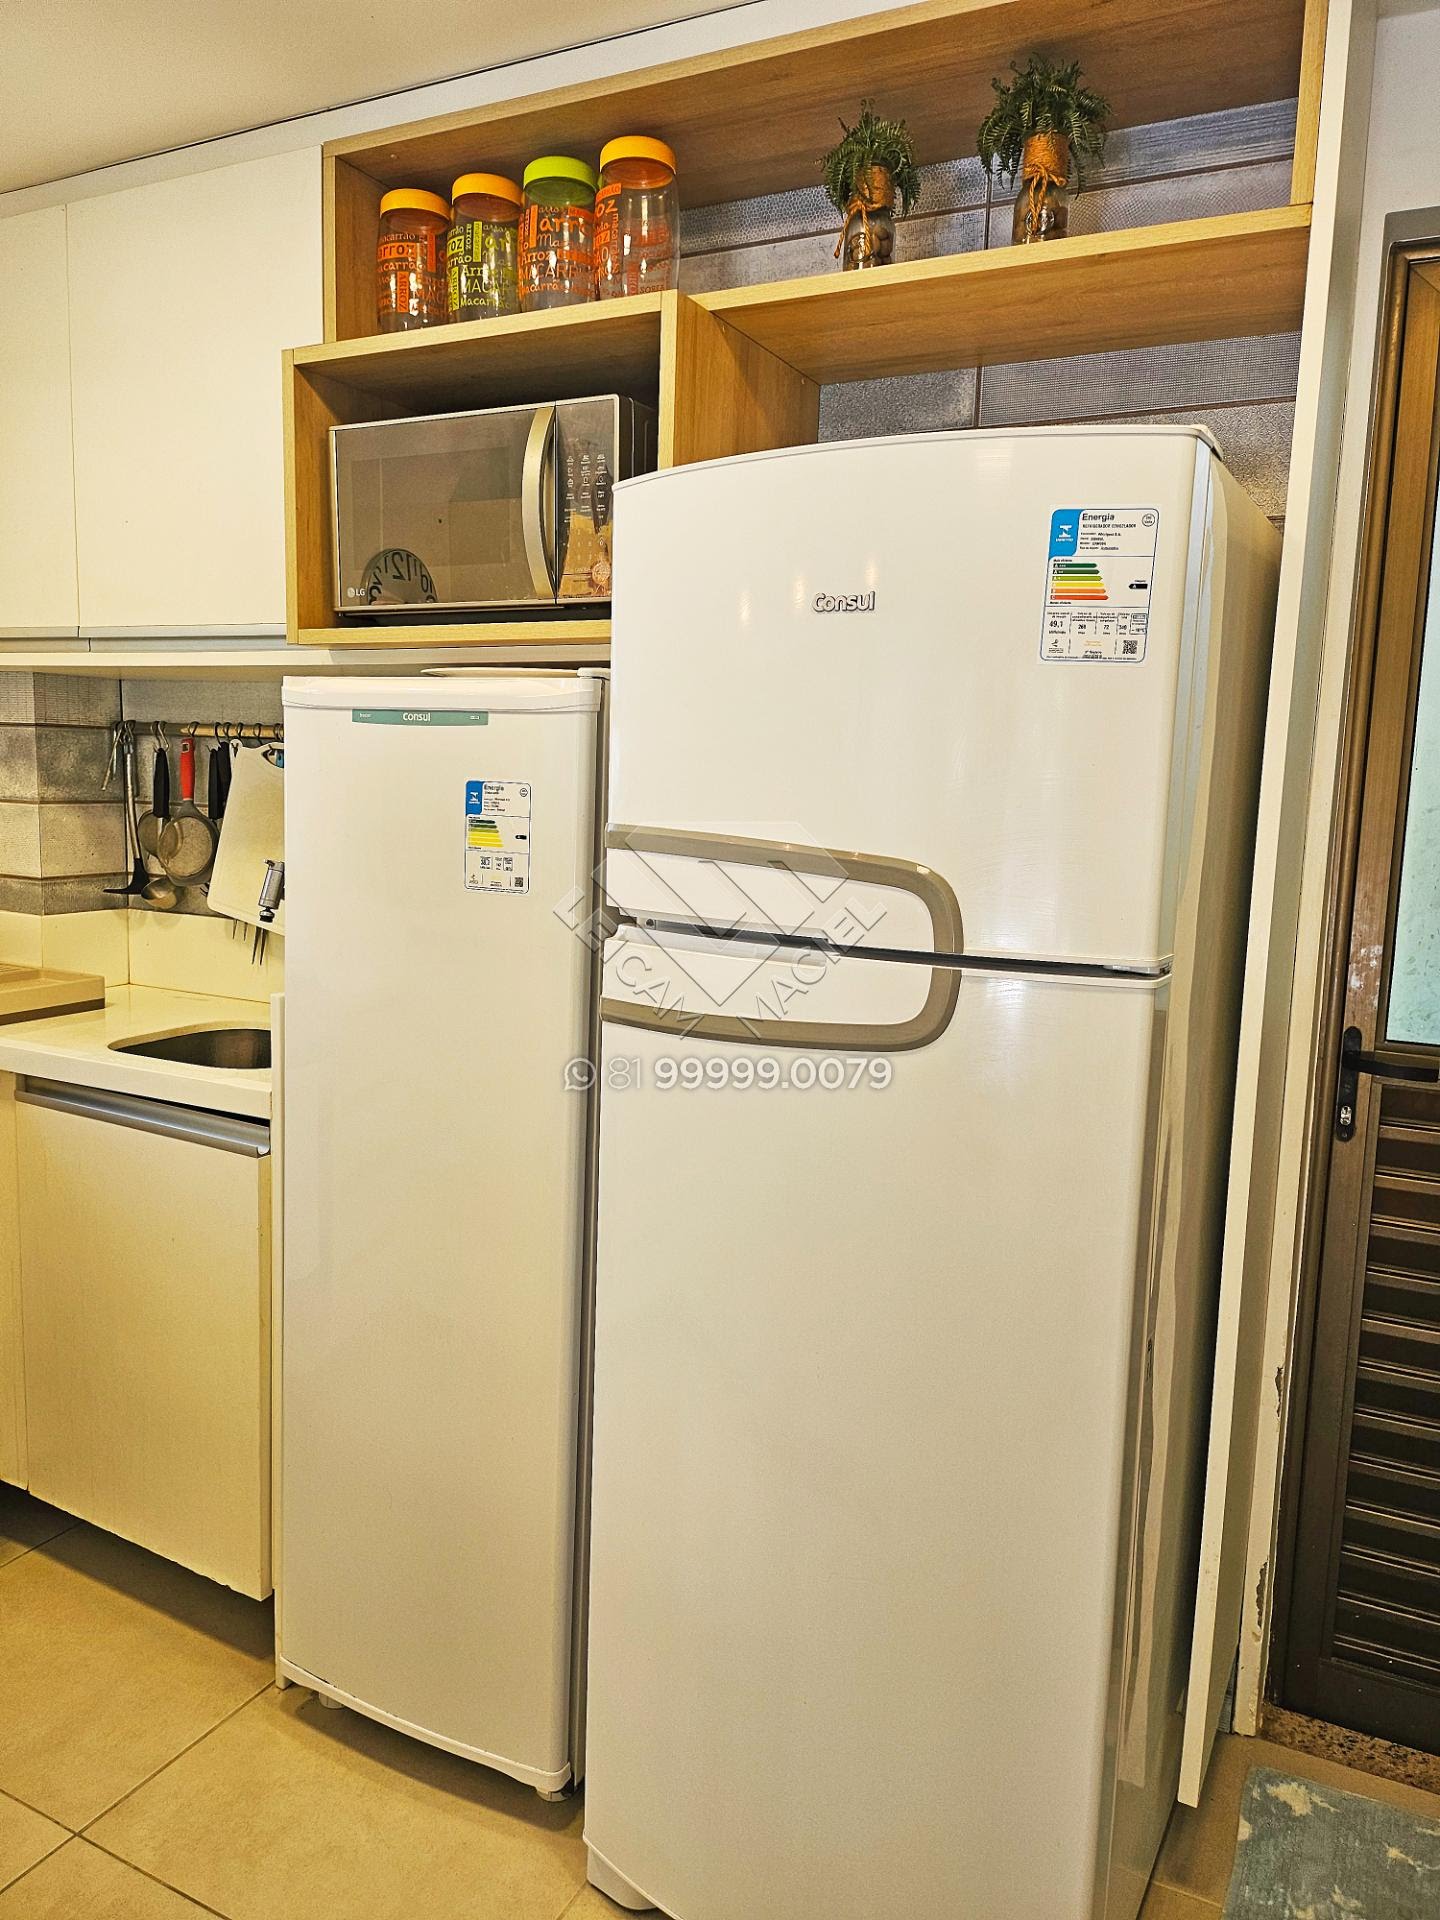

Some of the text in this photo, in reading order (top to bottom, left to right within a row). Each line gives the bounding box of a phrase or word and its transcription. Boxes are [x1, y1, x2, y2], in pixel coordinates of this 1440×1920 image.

[1082, 513, 1115, 522] Energia
[356, 588, 366, 596] LG
[812, 591, 875, 612] Consul
[402, 712, 431, 721] Consul
